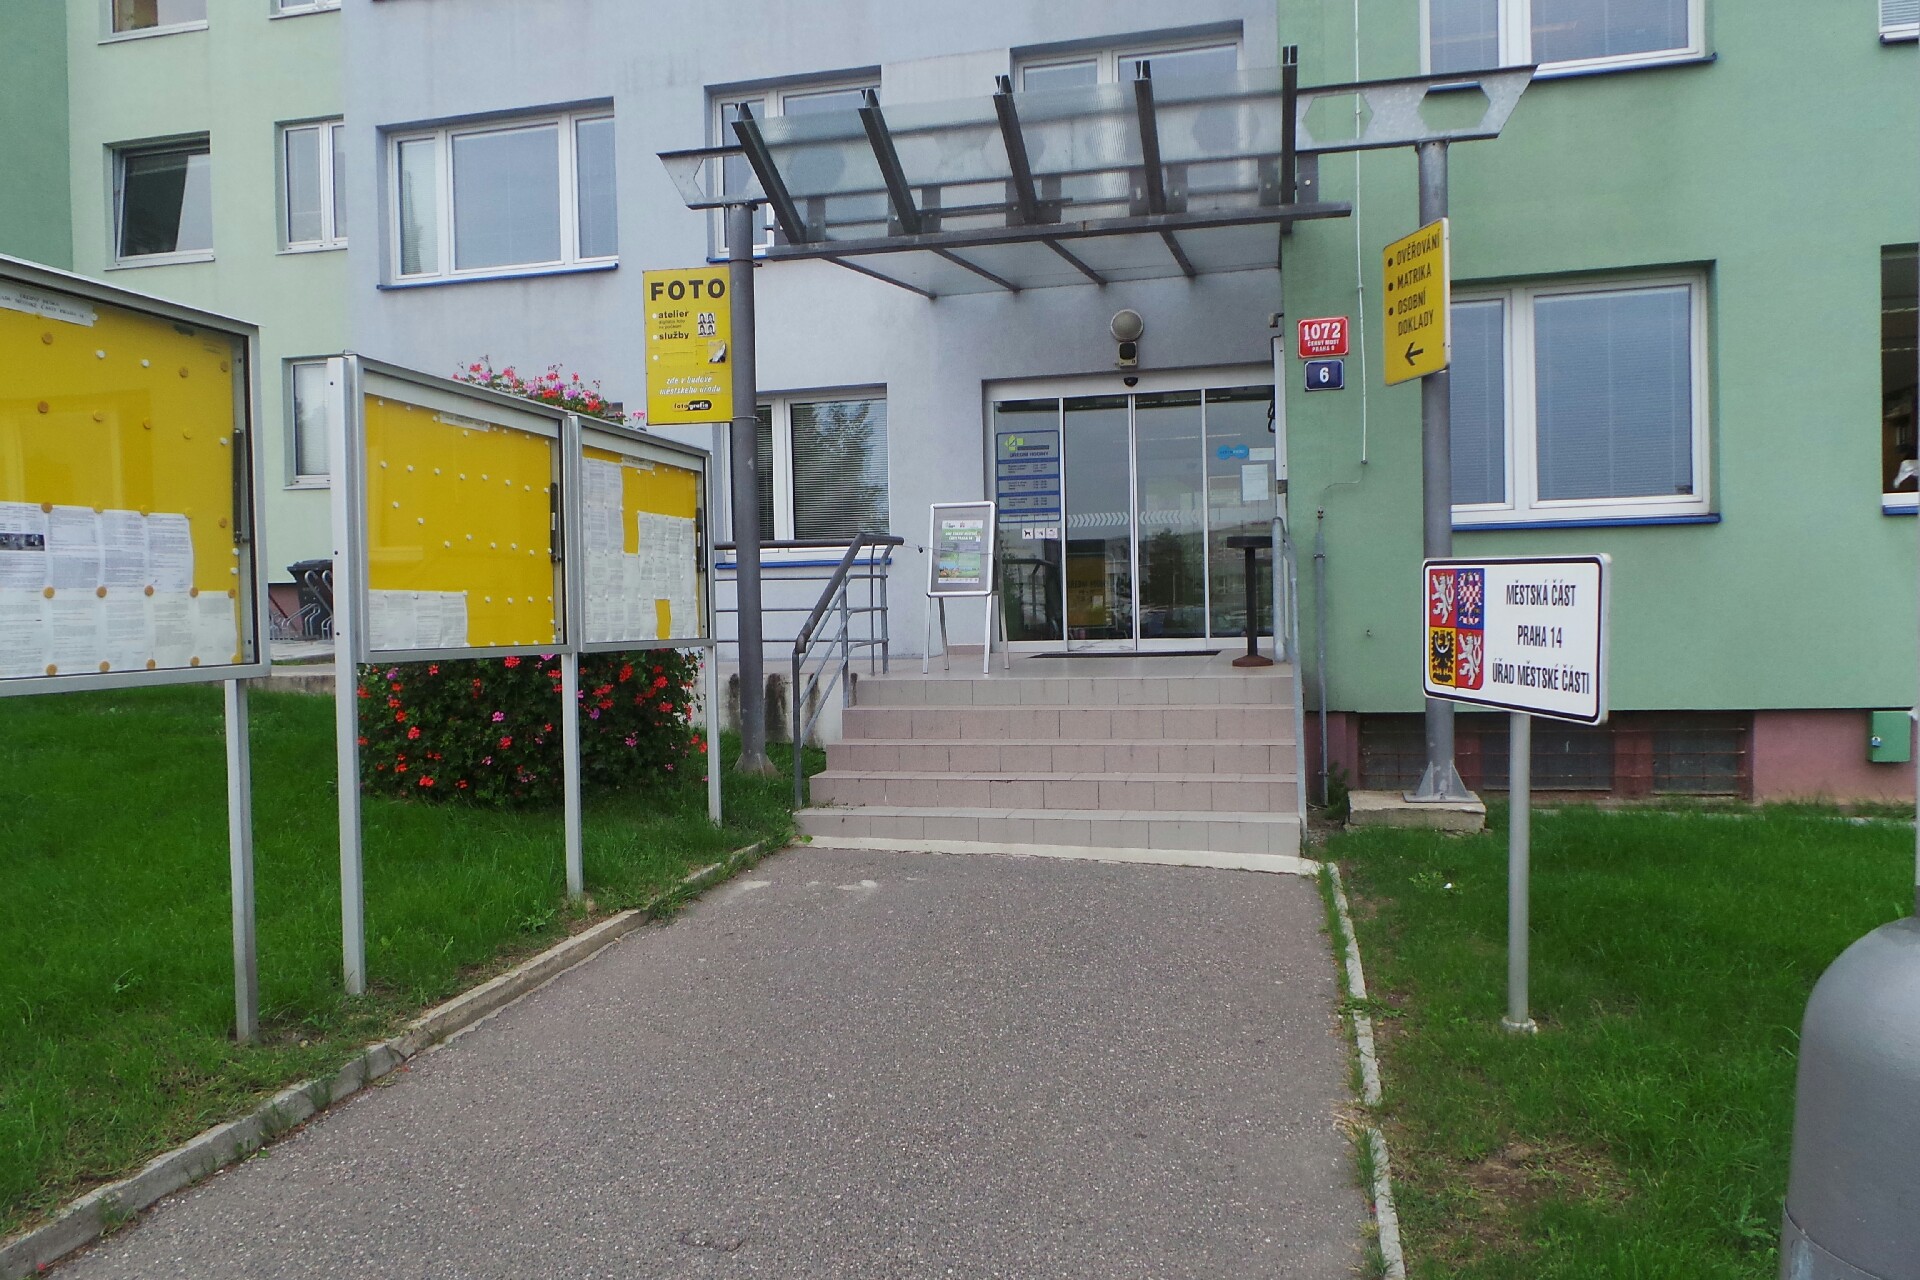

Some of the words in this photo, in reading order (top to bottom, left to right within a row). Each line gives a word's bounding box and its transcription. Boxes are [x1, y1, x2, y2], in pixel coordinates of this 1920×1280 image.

[1397, 228, 1440, 266] OVĚŘOVÁNÍ
[1397, 262, 1432, 290] MATRIKA
[650, 279, 726, 301] FOTO
[1397, 286, 1426, 315] OSOBNÍ
[658, 309, 690, 319] atelier
[1397, 309, 1434, 337] DOKLADY
[659, 330, 690, 341] služby
[1304, 322, 1341, 341] 1072
[1312, 345, 1331, 353] PRAHA
[666, 376, 679, 385] zde
[1319, 366, 1330, 383] 6
[1506, 578, 1549, 607] MĚSTSKÁ
[1552, 578, 1576, 607] ČÁST
[1517, 625, 1547, 648] PRAHA
[1550, 627, 1562, 648] 14
[1492, 657, 1514, 685] ÚŘAD
[1517, 660, 1558, 690] MĚSTSKÉ
[1562, 664, 1590, 695] ČÁSTI
